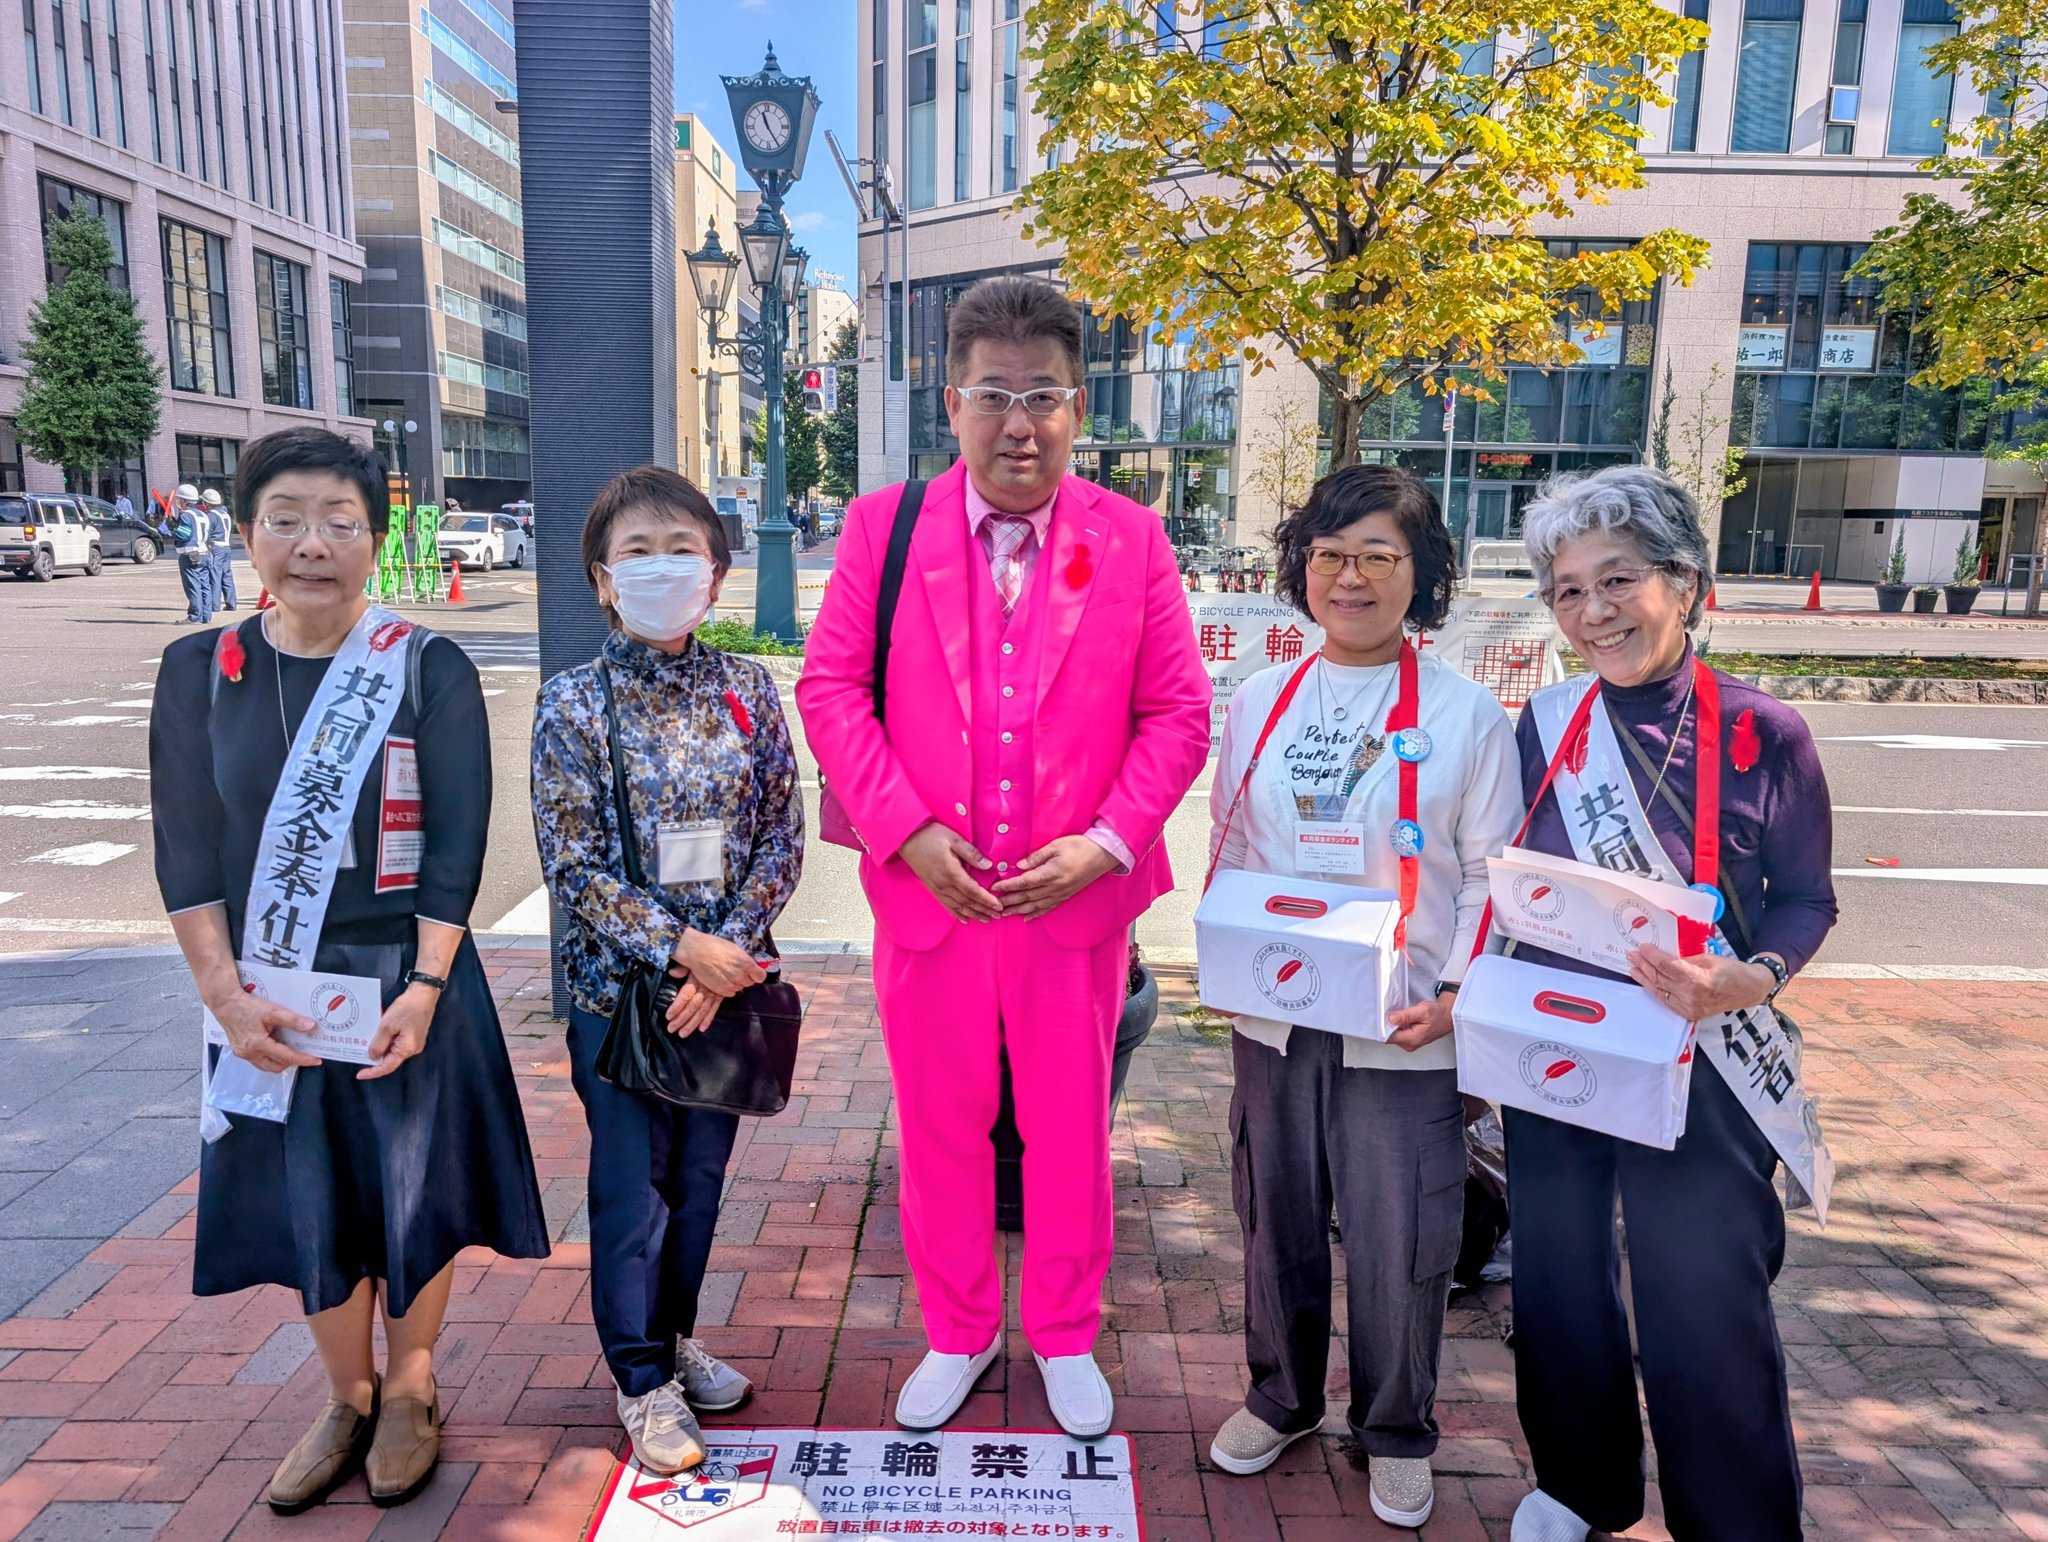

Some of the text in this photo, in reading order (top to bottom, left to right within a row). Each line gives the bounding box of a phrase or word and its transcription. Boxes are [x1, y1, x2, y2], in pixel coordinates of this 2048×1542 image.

[1823, 348, 1855, 363] 商店
[1200, 608, 1244, 616] BICYCLE
[1247, 608, 1294, 617] PARKING
[1304, 722, 1365, 745] Perfect
[822, 1485, 1073, 1501] NO BICYCLE PARKING
[673, 1509, 707, 1518] 札幌市
[819, 1500, 943, 1513] 禁止停车区域
[953, 1502, 1074, 1515] 자전거 주차금지
[776, 1520, 1126, 1539] 放置自転車は撤去の対象となります。
